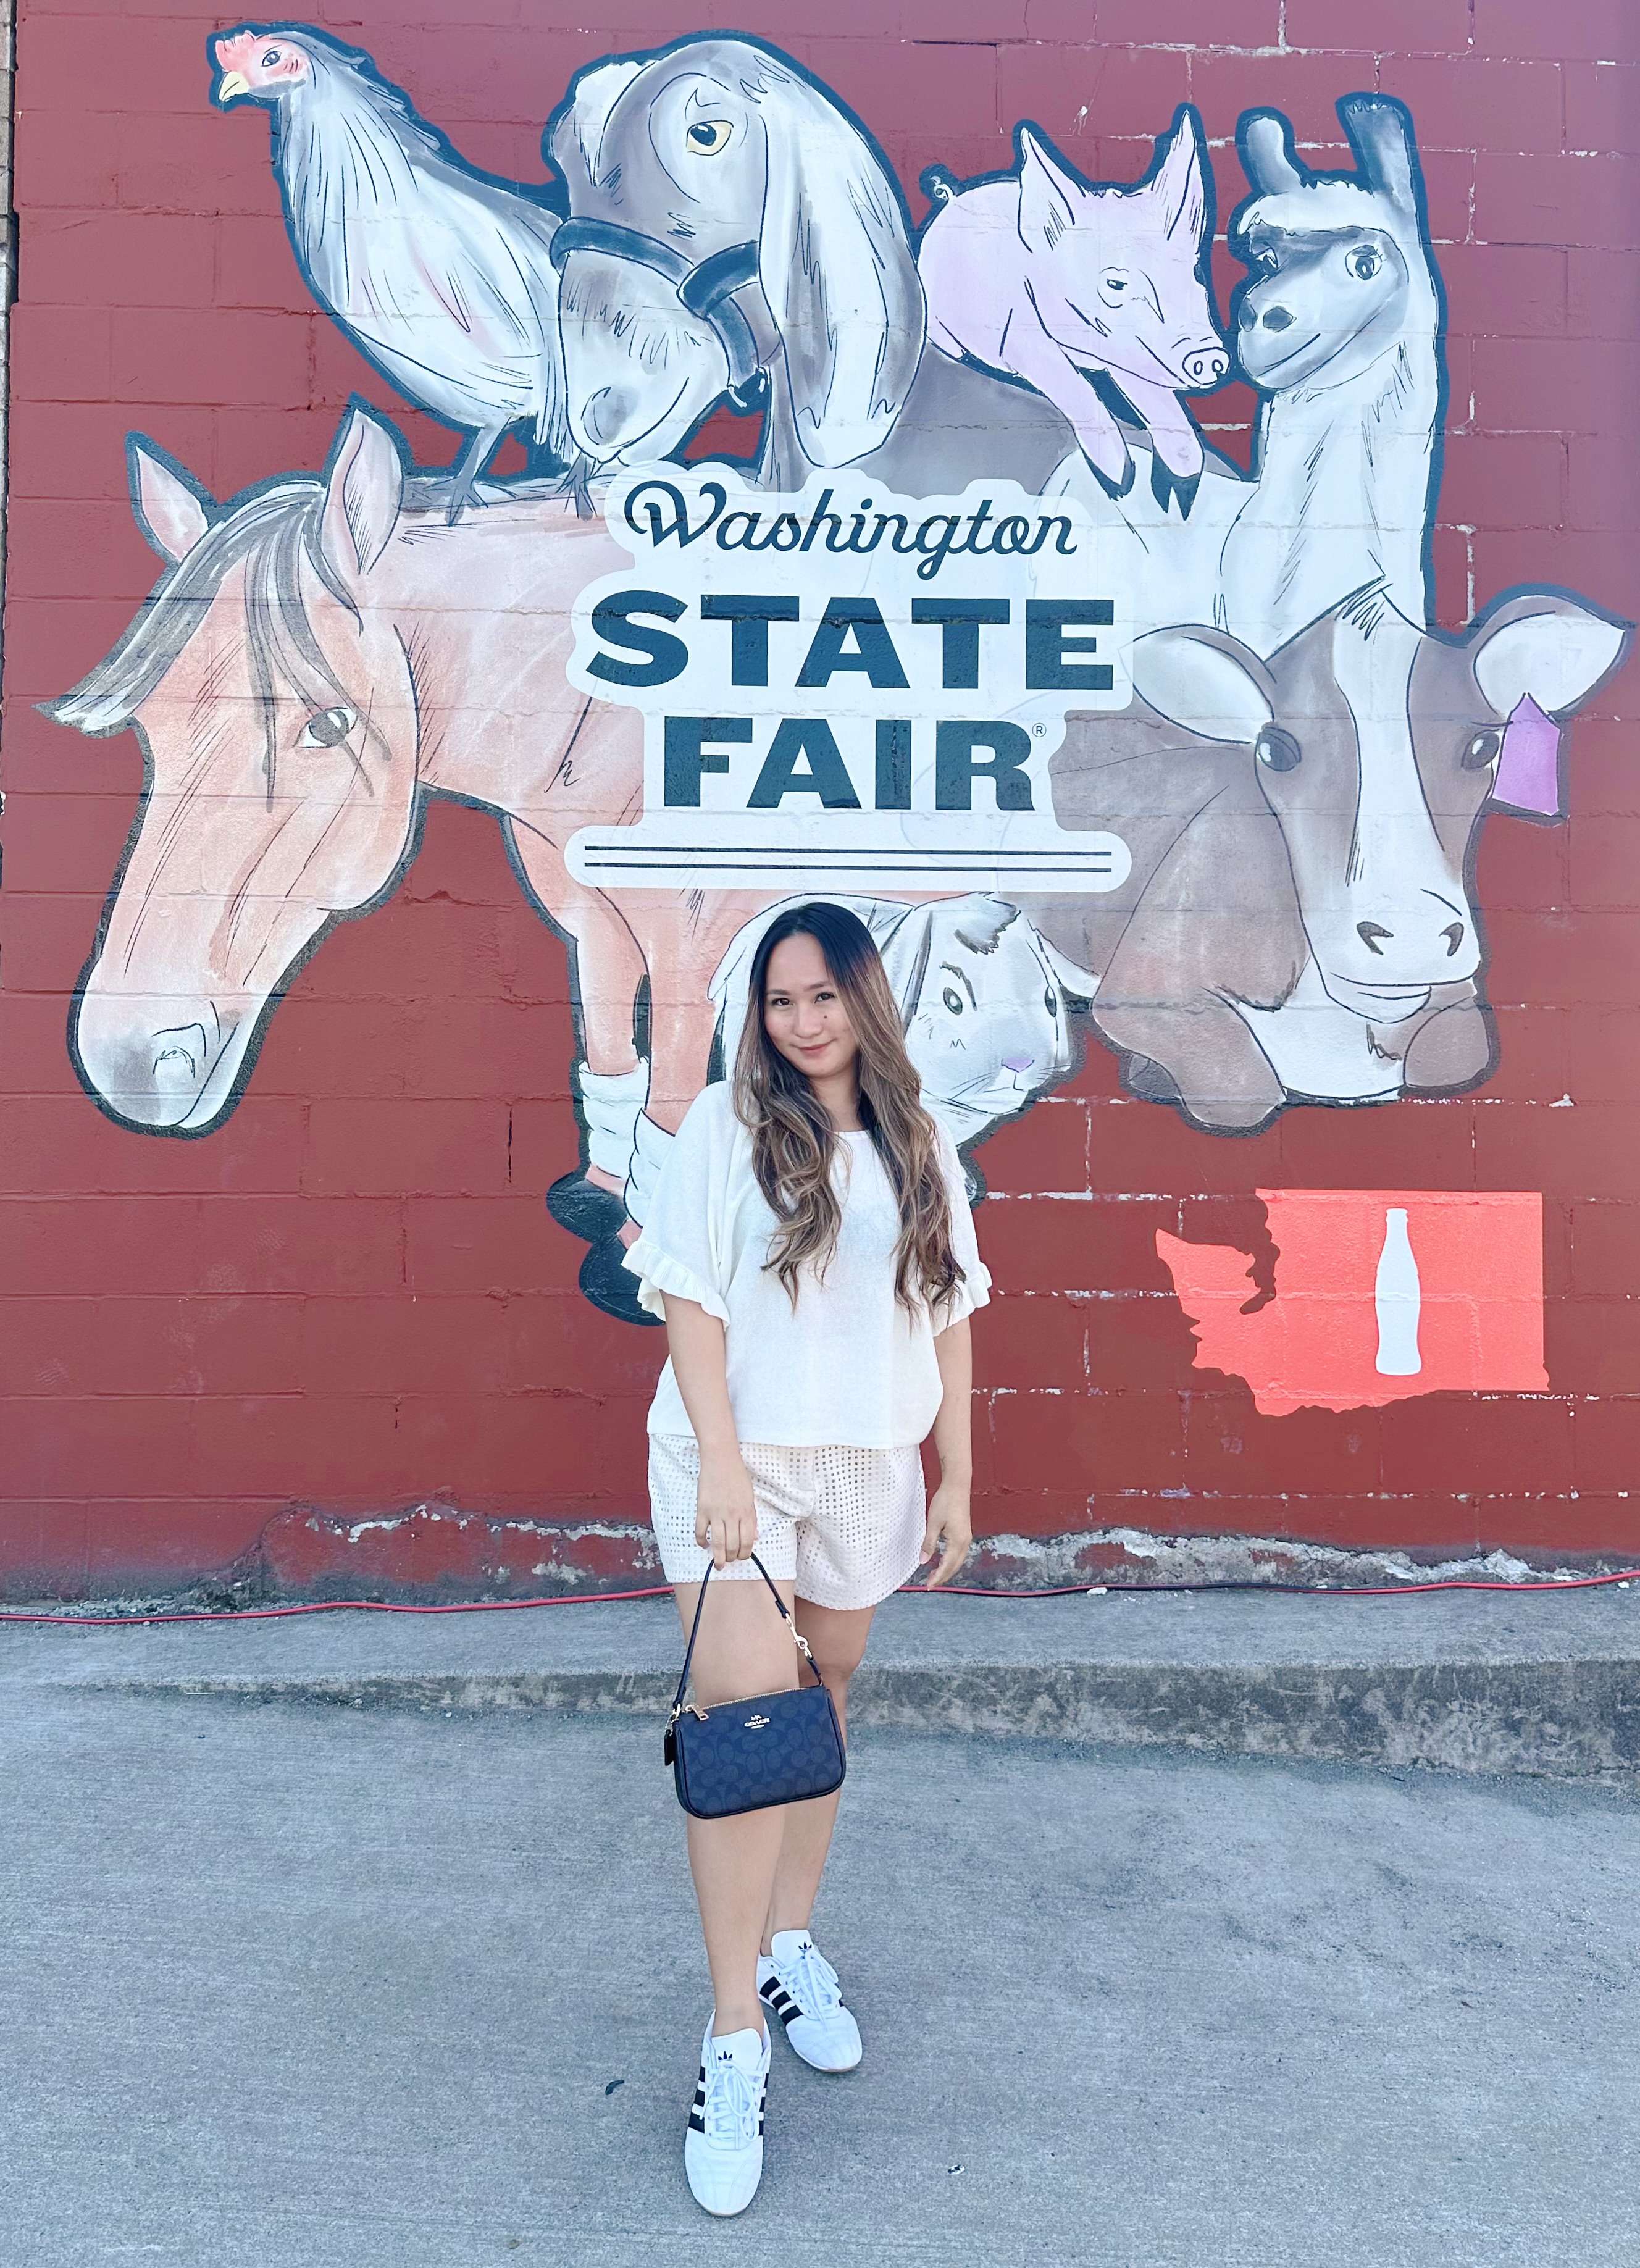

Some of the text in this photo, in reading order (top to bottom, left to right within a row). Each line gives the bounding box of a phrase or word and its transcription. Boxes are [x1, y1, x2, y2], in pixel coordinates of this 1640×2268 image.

[624, 480, 1077, 580] Washington
[585, 590, 1115, 690] STATE
[744, 1717, 770, 1727] COACH
